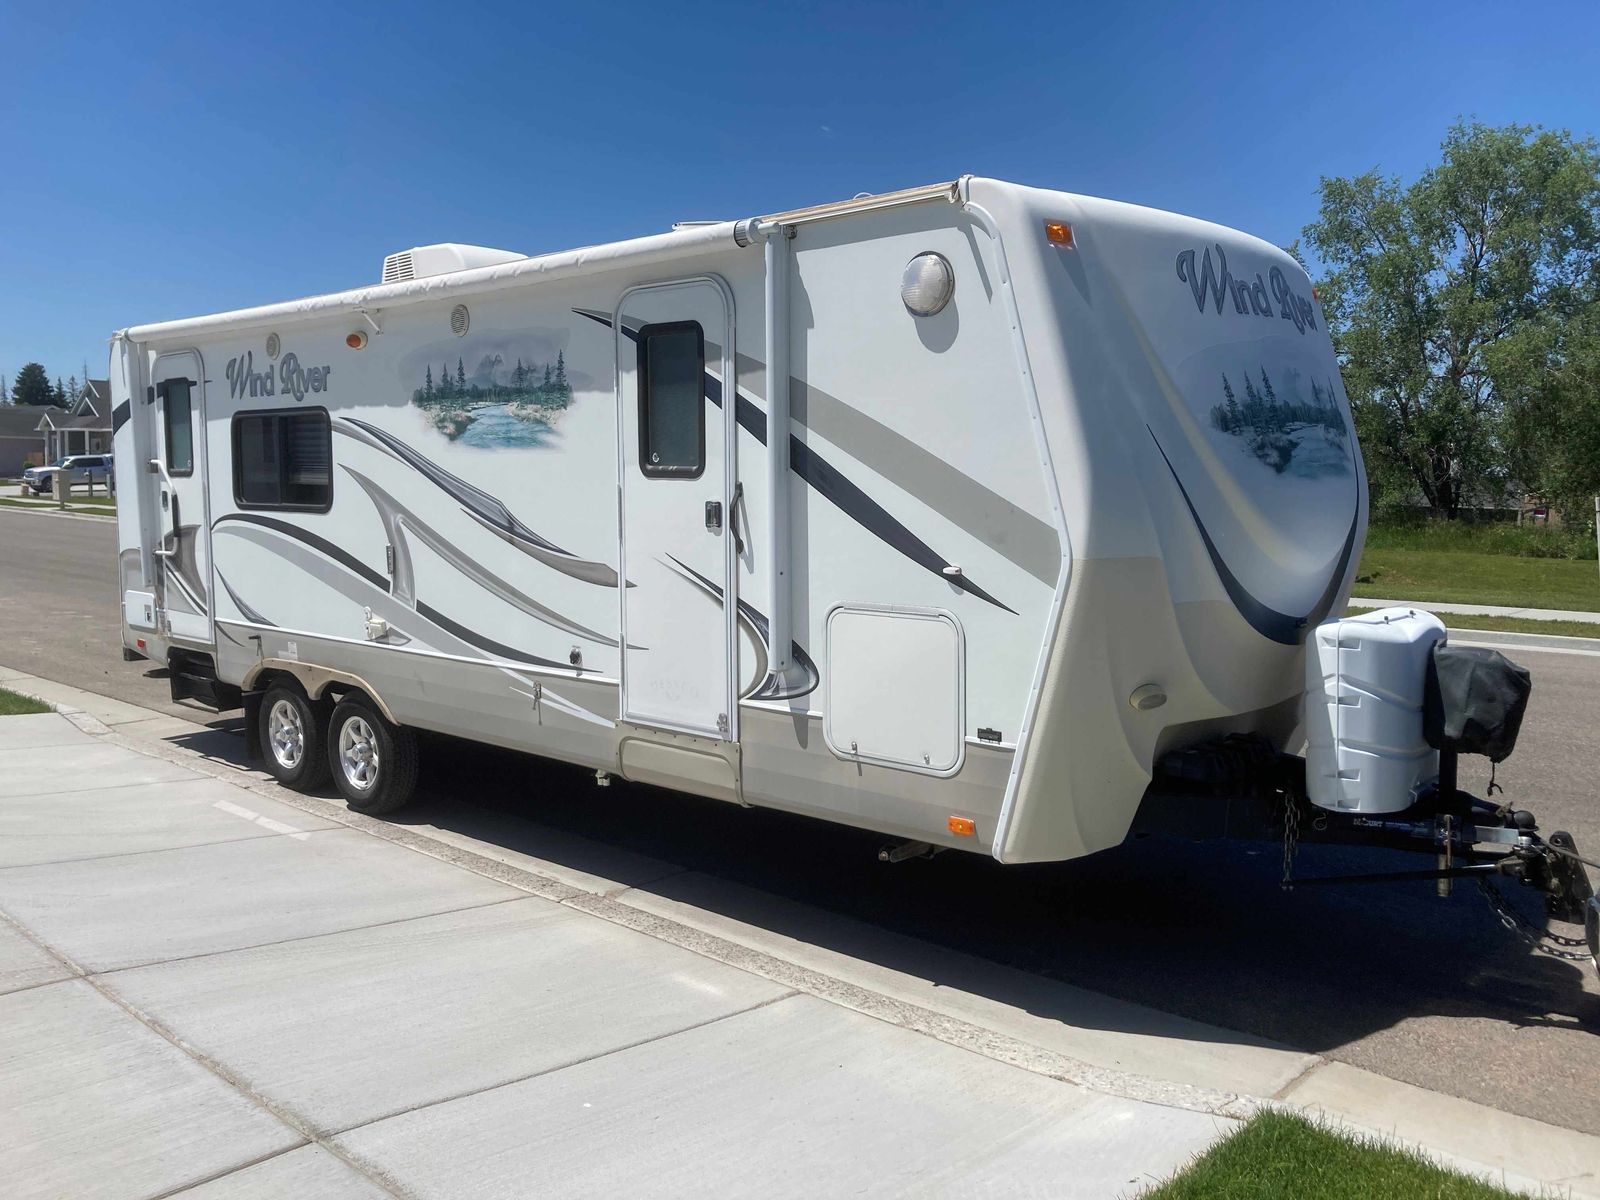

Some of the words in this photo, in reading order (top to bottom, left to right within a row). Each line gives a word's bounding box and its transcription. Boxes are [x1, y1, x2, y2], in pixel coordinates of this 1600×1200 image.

[1175, 243, 1273, 317] Wind
[1268, 265, 1318, 335] River
[226, 350, 275, 400] Wind
[279, 352, 331, 402] River
